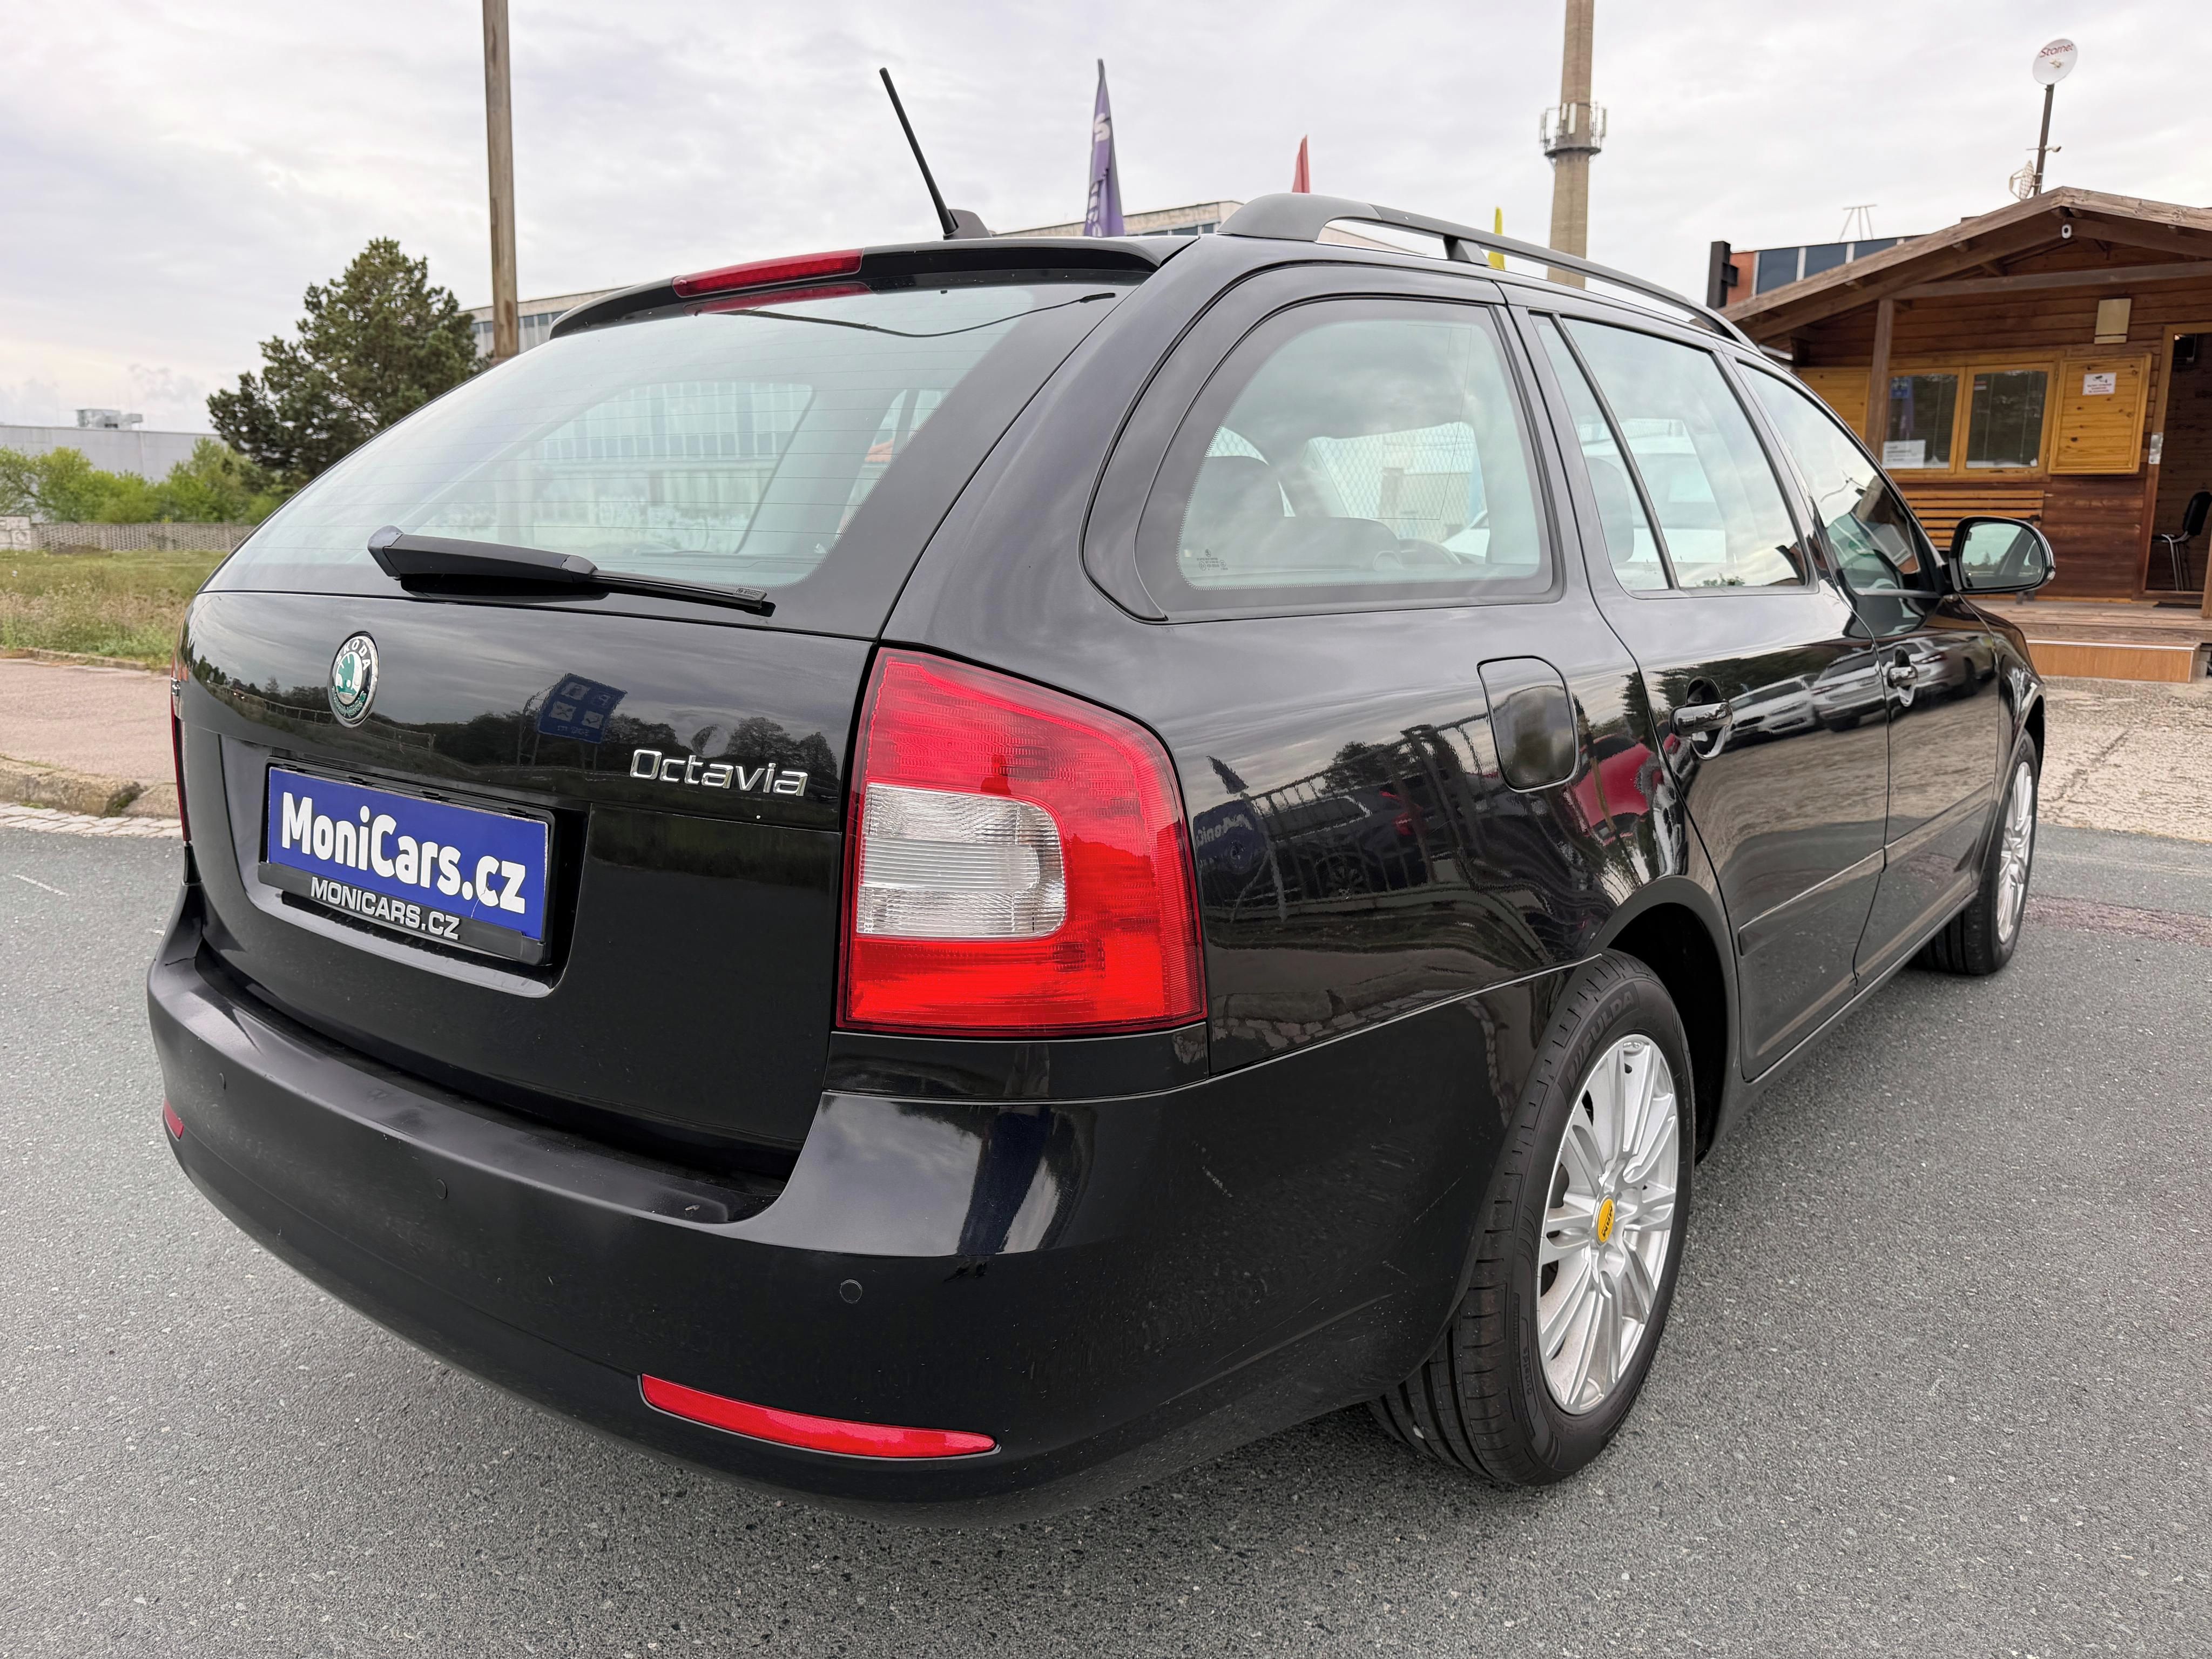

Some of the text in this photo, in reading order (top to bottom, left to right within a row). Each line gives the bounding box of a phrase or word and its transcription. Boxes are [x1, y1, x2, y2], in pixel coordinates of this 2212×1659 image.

[630, 749, 808, 797] Octavia
[281, 792, 526, 914] MoniCars.cz
[310, 876, 461, 941] MONICARS.CZ
[1581, 990, 1635, 1053] FULDA
